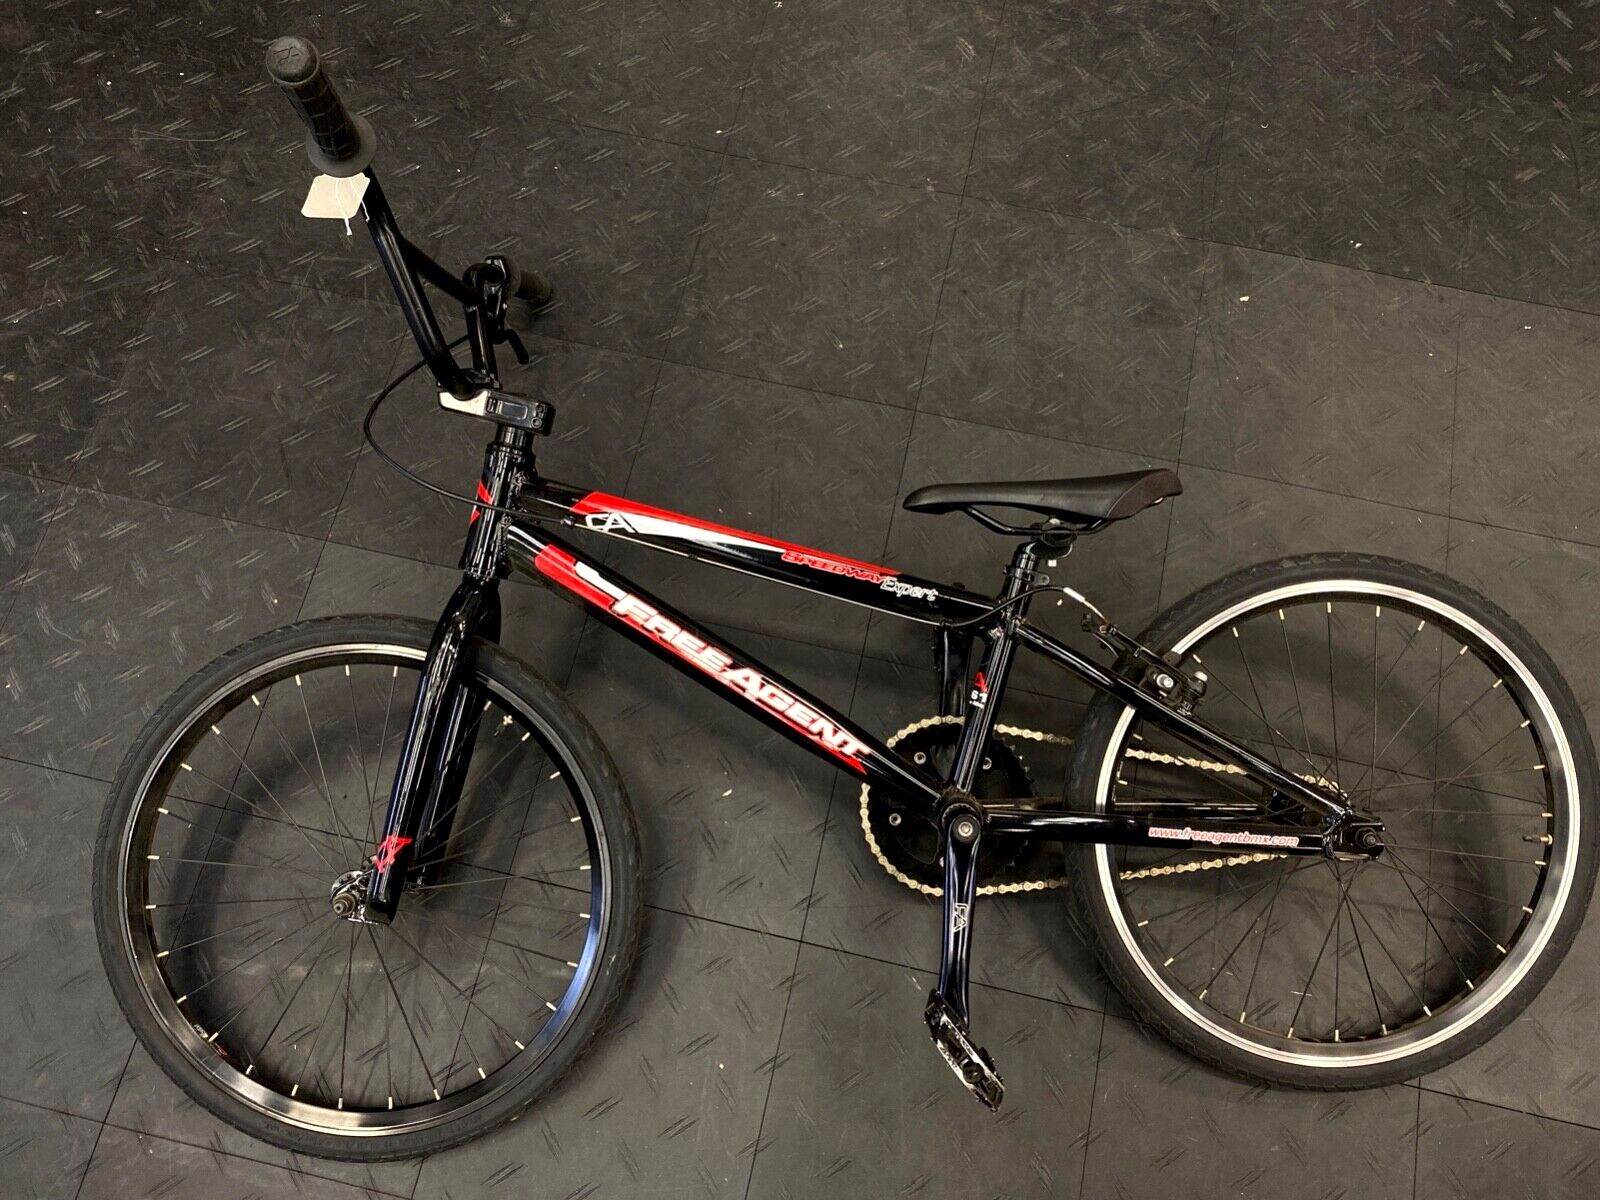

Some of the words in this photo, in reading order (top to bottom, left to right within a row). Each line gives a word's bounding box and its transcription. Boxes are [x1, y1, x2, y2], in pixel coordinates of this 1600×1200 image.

[781, 550, 884, 584] SPEEDWAY
[880, 576, 938, 601] Expert
[1148, 826, 1299, 847] www.freeagentbmx.com
